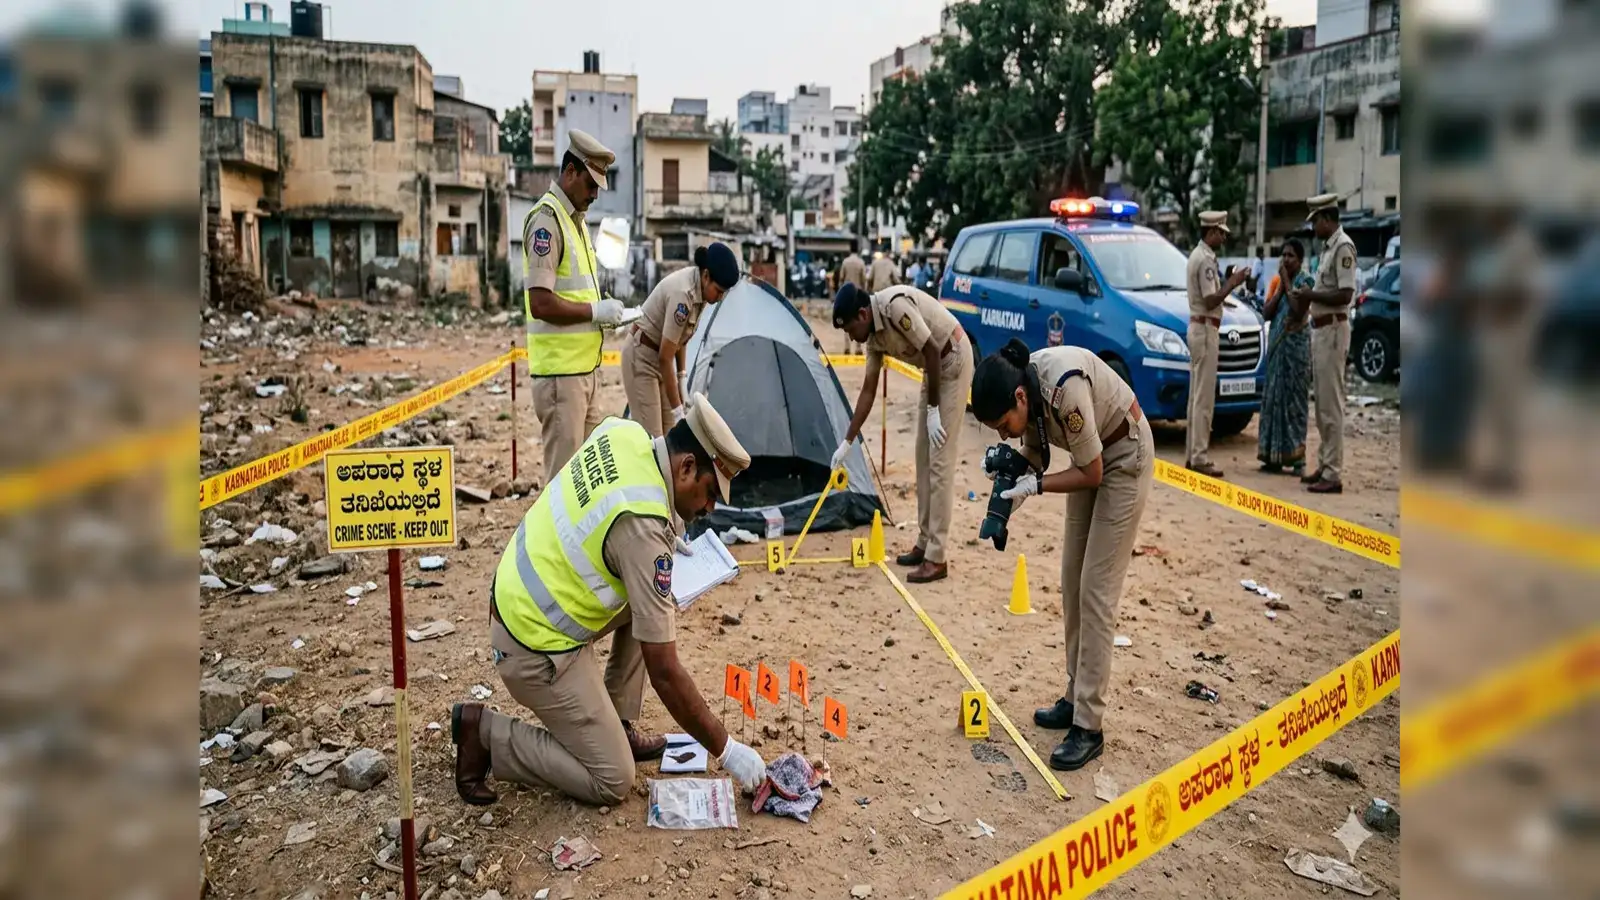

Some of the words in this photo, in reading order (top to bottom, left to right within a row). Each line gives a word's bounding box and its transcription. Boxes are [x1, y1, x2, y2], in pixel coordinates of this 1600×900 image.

[336, 458, 405, 482] ಅಪರಾಧ
[412, 456, 443, 490] ಸ್ಥಳ
[583, 444, 604, 490] POLICE
[335, 525, 364, 542] CRIME
[367, 523, 396, 541] SCENE
[404, 520, 428, 538] KEEP
[430, 519, 449, 537] OUT
[772, 546, 780, 564] 5
[856, 543, 865, 560] 4
[1370, 639, 1400, 690] KARN
[733, 673, 740, 691] 1
[764, 673, 772, 692] 2
[832, 707, 840, 726] 4
[970, 698, 982, 725] 2
[1178, 744, 1234, 811] ಅಪರಾಧ
[1065, 804, 1138, 889] POLICE
